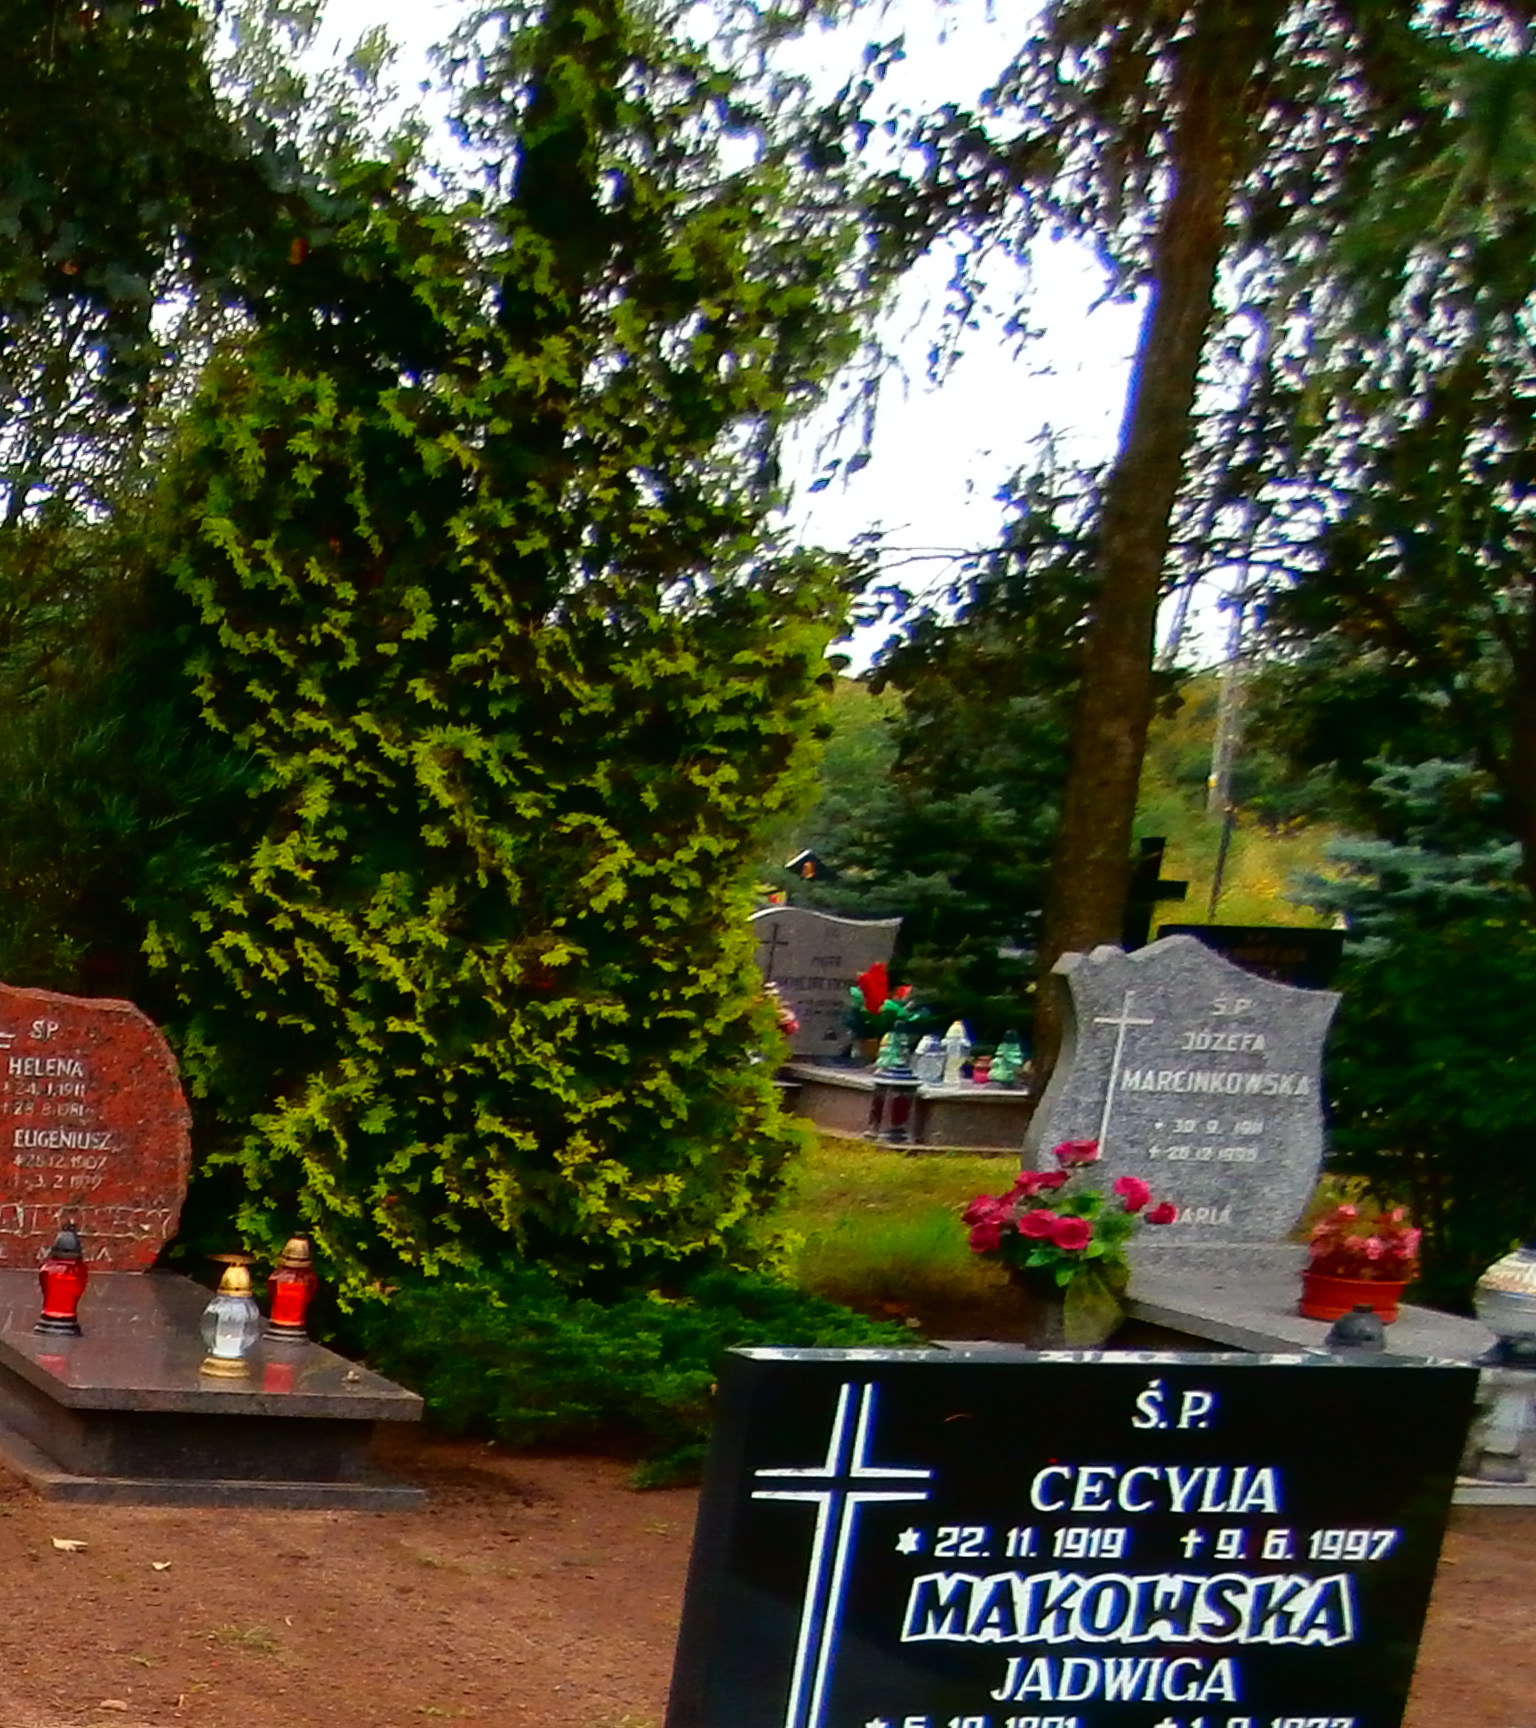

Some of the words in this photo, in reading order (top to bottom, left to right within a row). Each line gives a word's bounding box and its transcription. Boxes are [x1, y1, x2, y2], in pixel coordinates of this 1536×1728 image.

[8, 1057, 83, 1077] HELENA
[1120, 1070, 1310, 1096] MARCINKOWSKA
[13, 1128, 112, 1151] EUGENIUSZ
[1175, 1206, 1231, 1225] ARIA
[1030, 1466, 1279, 1514] CECYLIA
[934, 1527, 990, 1558] 22.
[1053, 1527, 1127, 1559] 1919
[1308, 1529, 1397, 1560] 1997
[899, 1570, 1355, 1646] MAKOWSKA
[990, 1656, 1238, 1702] JADWIGA
